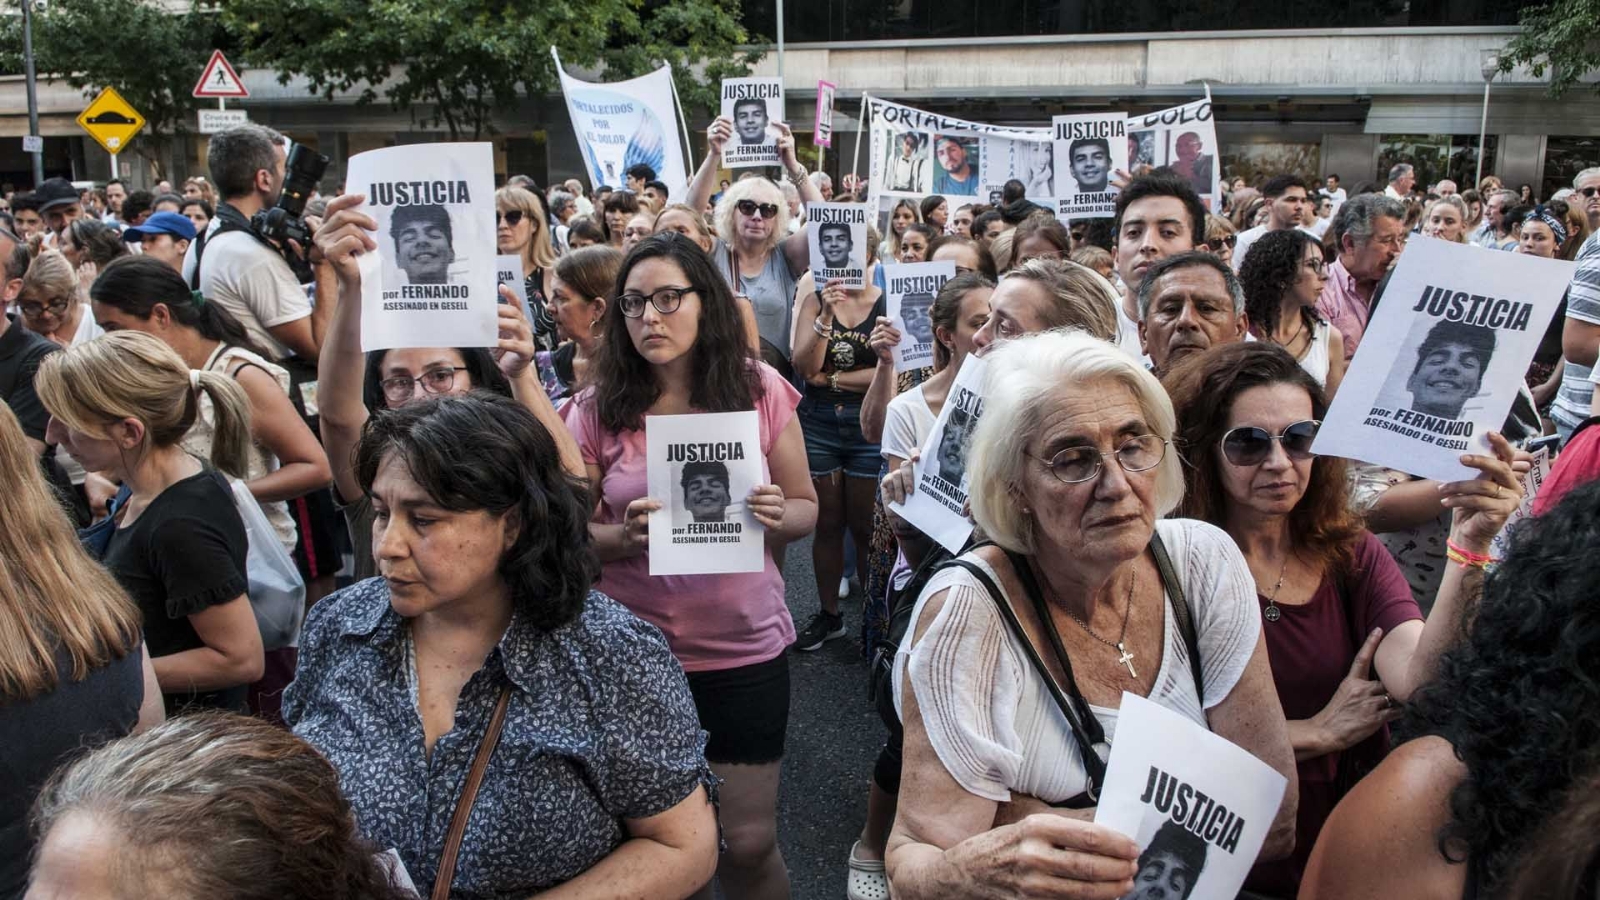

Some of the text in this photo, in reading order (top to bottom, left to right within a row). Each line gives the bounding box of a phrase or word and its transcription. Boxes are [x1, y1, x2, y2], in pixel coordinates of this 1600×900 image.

[724, 84, 780, 100] JUSTICIA
[592, 119, 610, 130] POR
[871, 102, 1211, 138] FORTALE DOLO
[1056, 120, 1125, 140] JUSTICIA
[598, 134, 626, 145] DOLOR
[737, 145, 779, 155] FERNANDO
[369, 180, 471, 206] JUSTICIA
[1074, 193, 1118, 205] FERNAN
[809, 208, 865, 224] JUSTICIA
[1060, 204, 1116, 214] ASESINADO EN GES
[823, 269, 863, 278] FERNANDO
[382, 285, 469, 300] por FERNANDO
[891, 275, 948, 295] JUSTICIA
[383, 301, 469, 311] ASESINADO EN GESELL
[1412, 285, 1534, 332] JUSTICIA
[949, 384, 986, 418] USTIC
[1369, 407, 1475, 438] por FERNANDO
[1363, 418, 1469, 451] ASESINADO EN GESELL
[667, 442, 744, 462] JUSTICIA
[919, 482, 943, 502] ASESINADO
[942, 499, 949, 509] EN
[922, 473, 969, 506] por FERNANDO
[672, 522, 742, 535] por FERNANDO
[672, 536, 709, 544] ASESINADO
[1140, 765, 1246, 855] JUSTICIA
